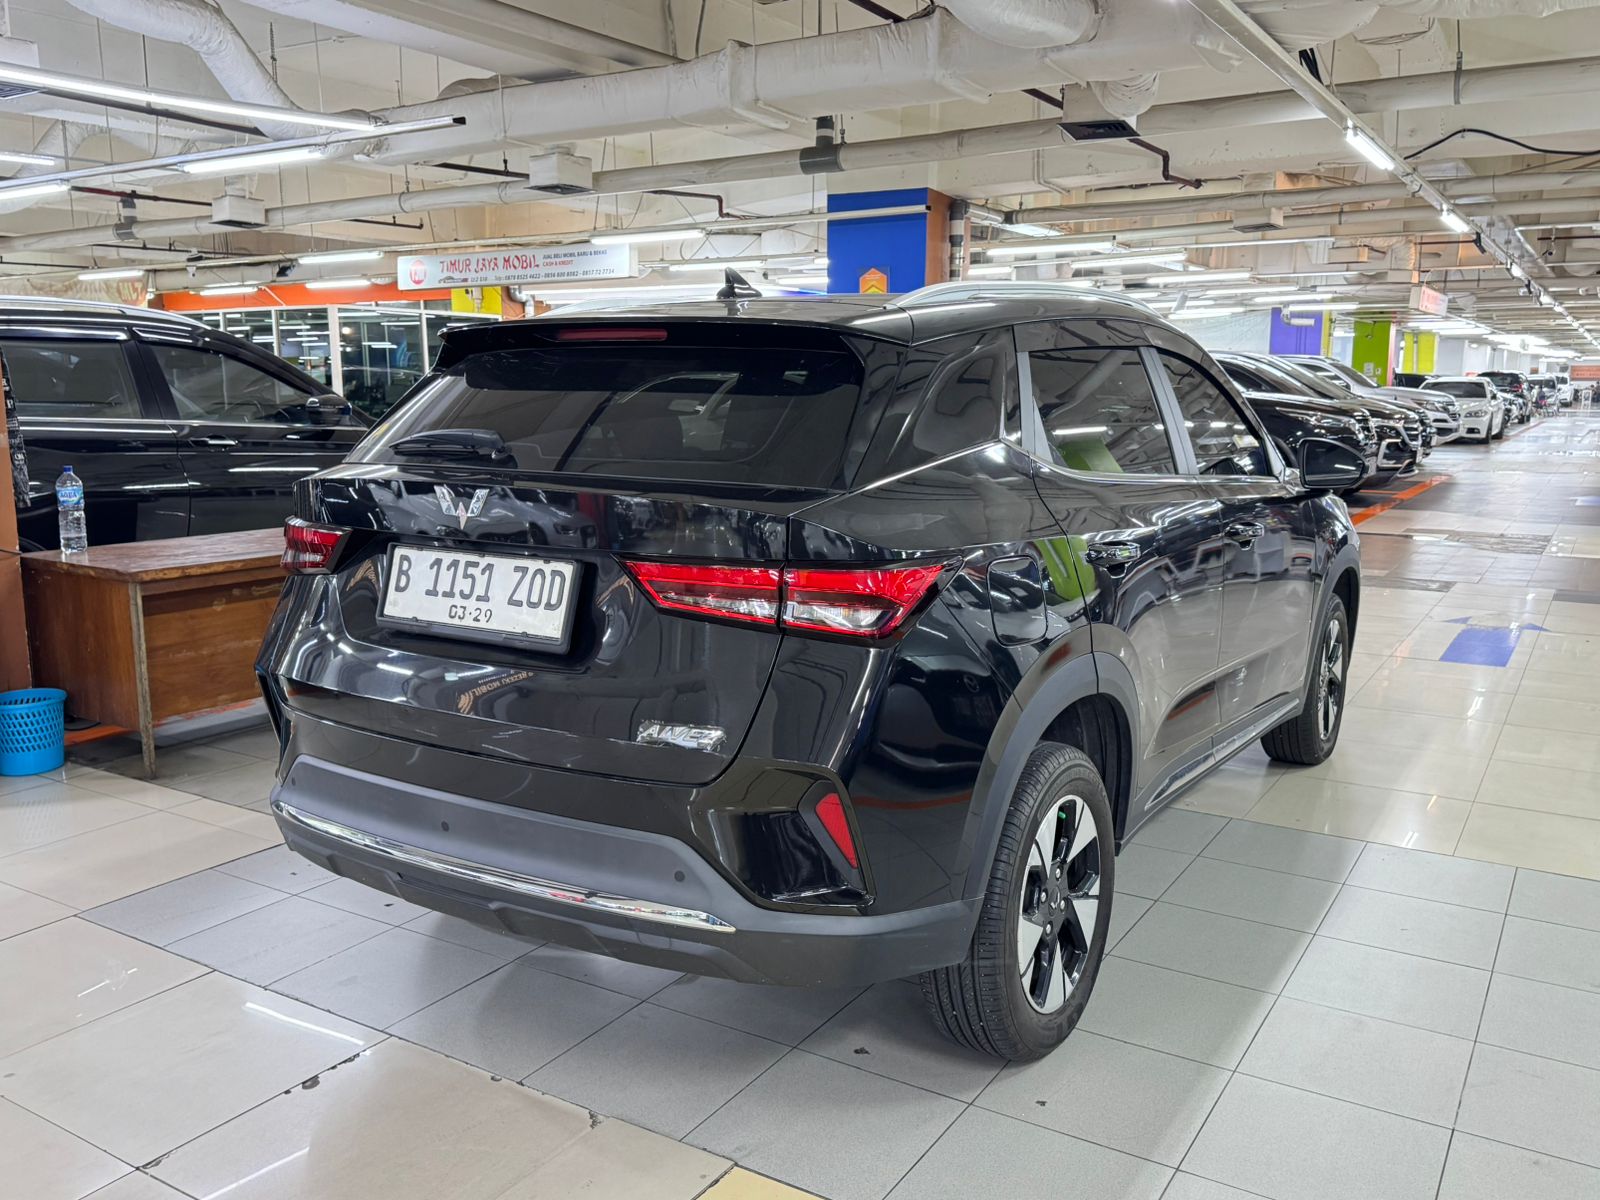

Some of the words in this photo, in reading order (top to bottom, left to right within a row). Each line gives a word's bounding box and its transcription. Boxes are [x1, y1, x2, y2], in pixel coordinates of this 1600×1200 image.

[439, 258, 472, 274] TIMUR
[474, 256, 499, 274] JAYA
[502, 254, 540, 272] MOBIL
[394, 554, 413, 593] B
[424, 557, 495, 603] 1151
[507, 565, 567, 612] ZOD
